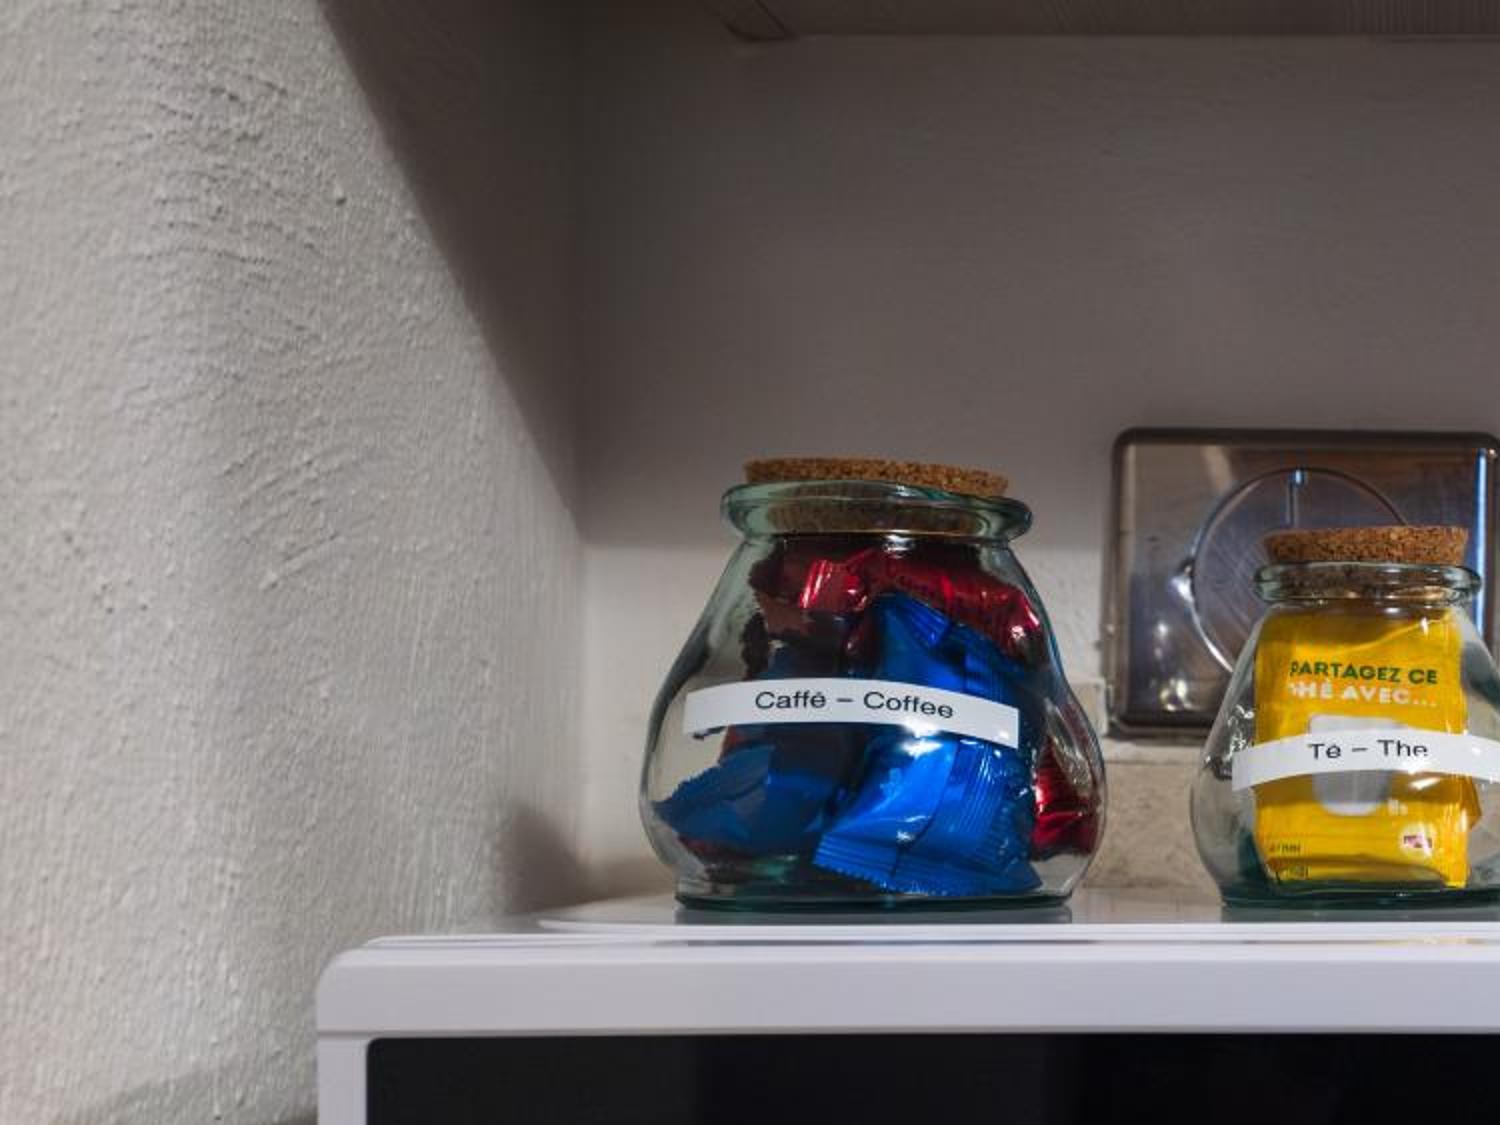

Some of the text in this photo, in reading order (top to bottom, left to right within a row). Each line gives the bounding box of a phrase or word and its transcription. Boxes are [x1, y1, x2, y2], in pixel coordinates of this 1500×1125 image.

[1290, 661, 1438, 685] PARTAGEZ CE
[863, 691, 954, 719] Coffee
